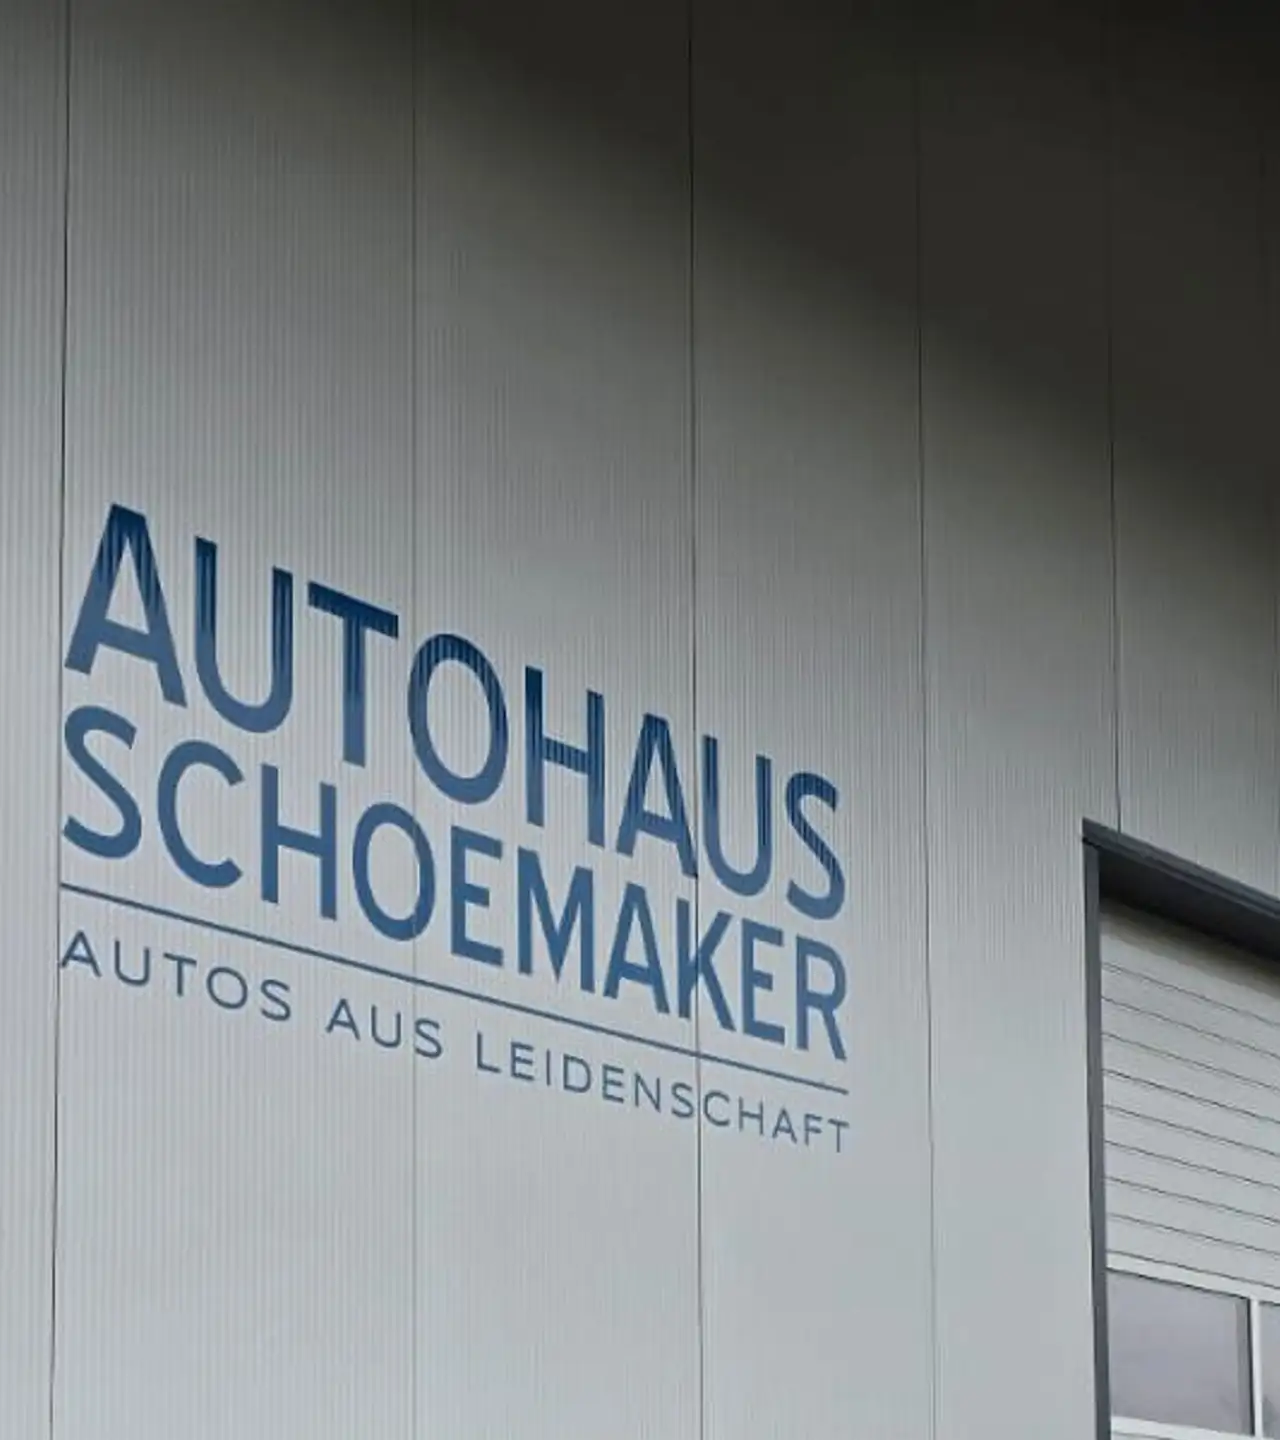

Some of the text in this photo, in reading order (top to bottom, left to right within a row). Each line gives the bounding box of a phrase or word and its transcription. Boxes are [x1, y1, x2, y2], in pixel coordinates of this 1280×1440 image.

[63, 704, 848, 1060] SCHOEMAKER
[64, 502, 846, 920] AUTOHAUS
[60, 930, 851, 1153] AUTOS AUS LEIDENSCHAFT
